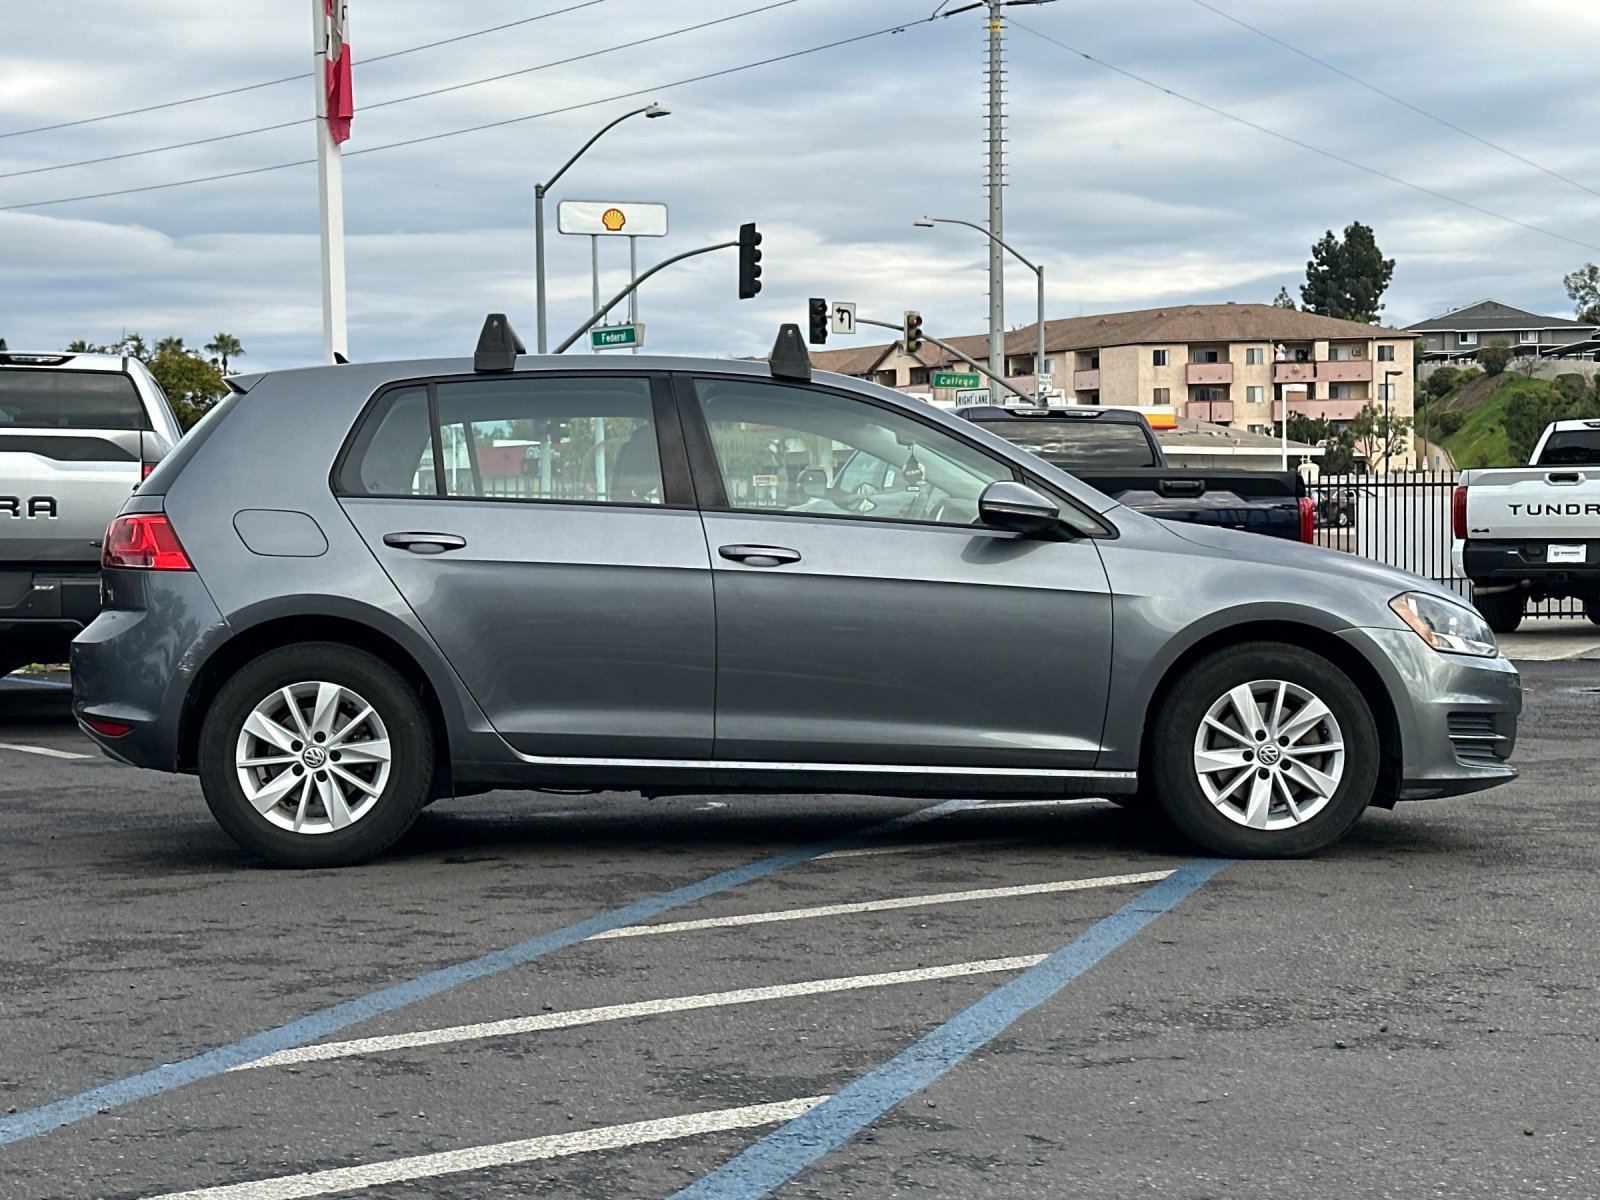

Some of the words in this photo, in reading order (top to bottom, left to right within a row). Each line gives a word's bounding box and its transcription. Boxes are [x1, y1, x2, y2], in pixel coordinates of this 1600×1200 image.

[601, 331, 627, 343] Federal
[940, 376, 974, 387] College
[958, 395, 973, 406] RIGHT
[975, 394, 989, 405] LANE
[1507, 504, 1600, 516] TUNDR
